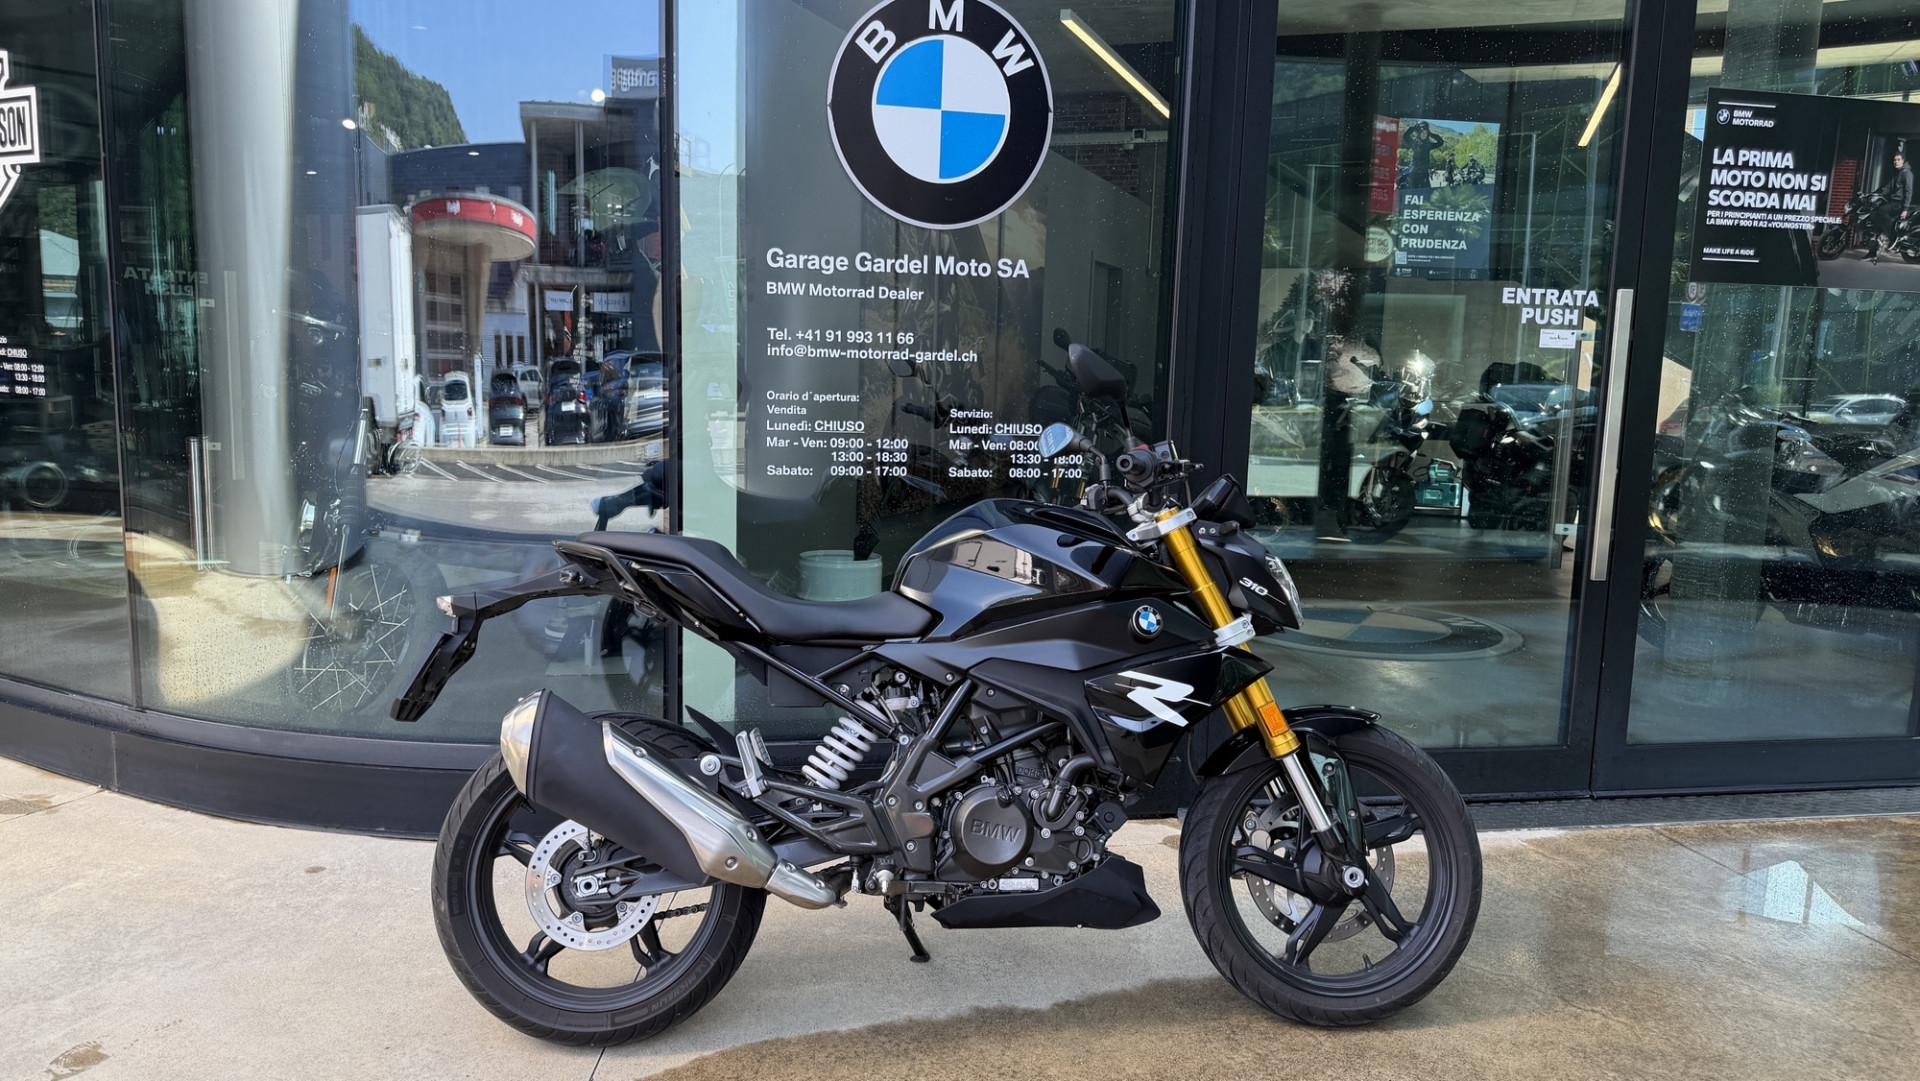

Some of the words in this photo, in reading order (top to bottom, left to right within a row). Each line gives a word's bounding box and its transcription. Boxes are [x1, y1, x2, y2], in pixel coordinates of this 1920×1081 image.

[854, 0, 1035, 78] BMW
[1733, 110, 1753, 118] BMW
[1732, 118, 1774, 128] MOTORRAD
[1712, 148, 1734, 166] LA
[1737, 151, 1794, 169] PRIMA
[1710, 169, 1765, 187] MOTO
[1768, 173, 1807, 191] NON
[1810, 175, 1827, 192] SI
[1404, 194, 1424, 206] FAI
[1708, 190, 1779, 209] SCORDA
[1782, 194, 1817, 211] MAI
[1403, 210, 1480, 222] ESPERIENZA
[1784, 214, 1810, 222] PREZZO
[1402, 224, 1429, 234] CON
[1400, 238, 1468, 250] PRUDENZA
[766, 248, 849, 274] Garage
[855, 252, 928, 274] Gardel
[935, 255, 991, 278] Moto
[997, 258, 1030, 279] SA
[766, 281, 806, 295] BMW
[809, 283, 875, 299] Motorrad
[879, 287, 924, 301] Dealer
[1502, 287, 1599, 306] ENTRATA
[1521, 308, 1579, 325] PUSH
[767, 328, 792, 341] Tel.
[795, 329, 821, 342] +41
[825, 330, 842, 343] 91
[846, 331, 873, 344] 993
[877, 332, 892, 344] 11
[896, 332, 914, 345] 66
[767, 345, 978, 363] info@bmw-motorrad-gardel.ch
[766, 391, 799, 401] Orario
[767, 405, 807, 415] Vendita
[950, 408, 993, 419] Servizio:
[766, 420, 812, 432] Lunedì:
[814, 420, 865, 433] CHIUSO
[950, 423, 992, 435] Lunedì:
[994, 423, 1043, 436] CHIUSO
[766, 437, 790, 448] Mar
[801, 438, 827, 449] Ven:
[830, 438, 864, 449] 09:00
[876, 438, 908, 449] 12:00
[949, 440, 972, 450] Mar
[982, 440, 1006, 451] Ven:
[831, 451, 864, 462] 13:00
[876, 452, 907, 463] 18:30
[1010, 454, 1041, 464] 13:30
[767, 465, 813, 477] Sabato:
[830, 465, 864, 477] 09:00
[875, 466, 907, 477] 17:00
[949, 467, 993, 479] Sabato:
[1009, 467, 1041, 479] 08:00
[1052, 468, 1082, 479] 17:00
[1239, 577, 1268, 596] 310
[970, 818, 1021, 843] BMW
